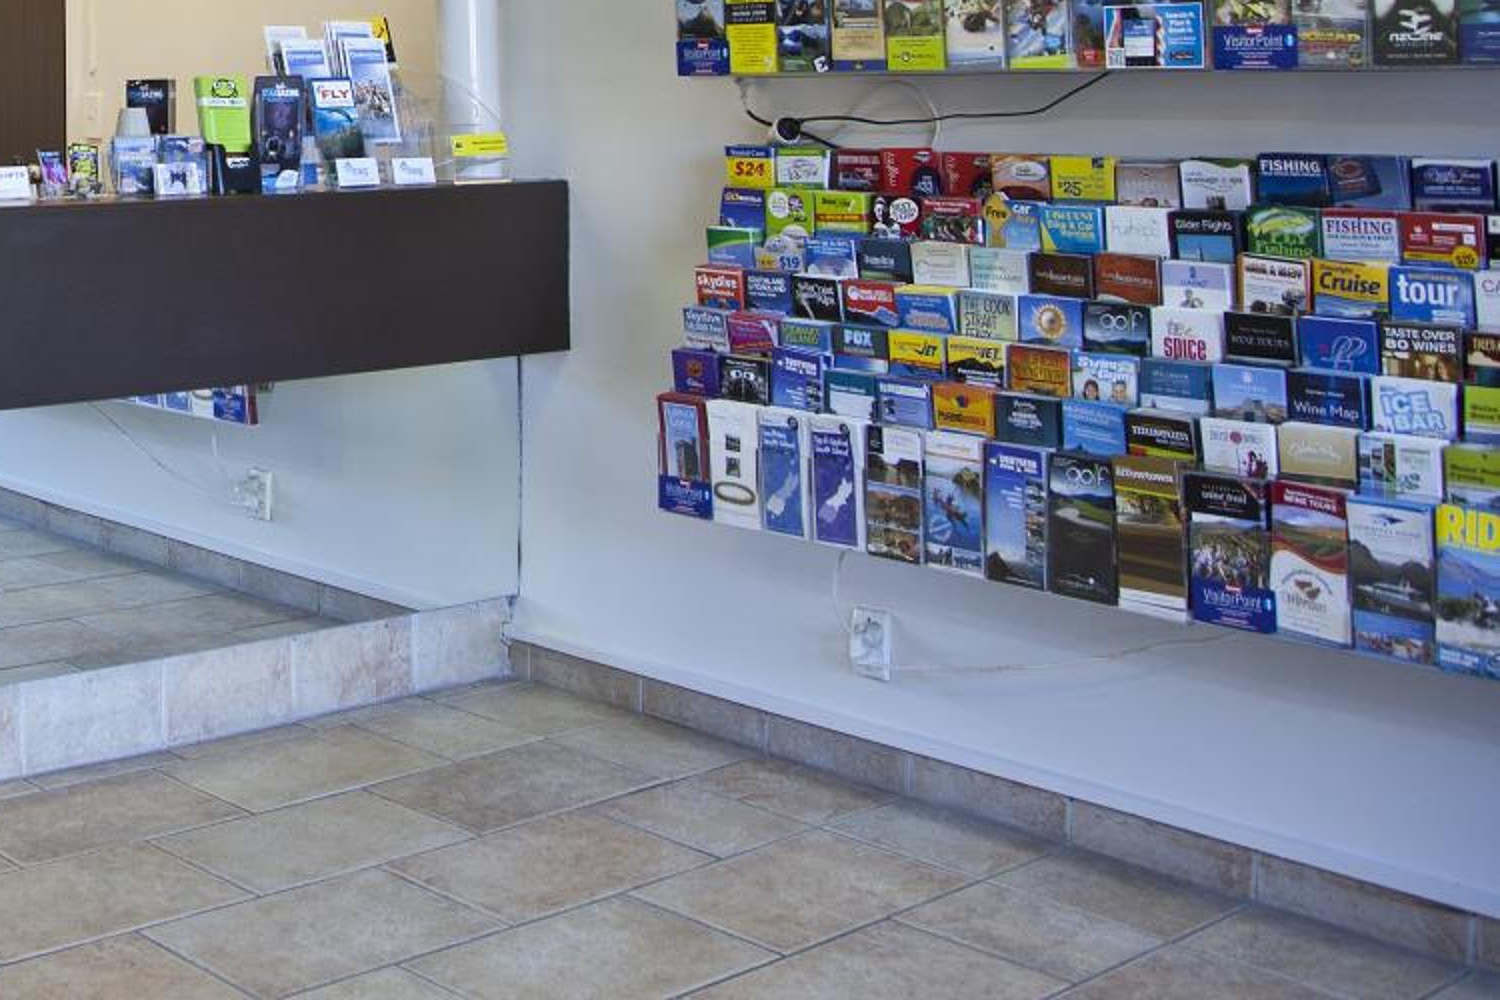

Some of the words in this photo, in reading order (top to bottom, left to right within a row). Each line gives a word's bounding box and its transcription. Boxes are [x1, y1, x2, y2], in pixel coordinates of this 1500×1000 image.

[1223, 33, 1283, 47] VisitorPoint
[321, 89, 350, 100] FLY
[734, 160, 765, 176] $24
[1259, 159, 1321, 174] FISHING
[1326, 219, 1393, 235] FISHING
[1319, 271, 1382, 295] Cruise
[1396, 273, 1459, 305] tour
[983, 299, 1012, 315] COOK
[843, 329, 872, 346] FOX
[1384, 327, 1418, 340] TASTE
[1421, 329, 1456, 342] OVER
[1412, 341, 1456, 354] WINES
[1293, 400, 1328, 417] Wine
[1328, 404, 1359, 422] Map
[1381, 391, 1430, 416] ICE
[1392, 410, 1446, 435] BAR
[1310, 500, 1338, 513] TOURS
[1436, 504, 1500, 552] RID
